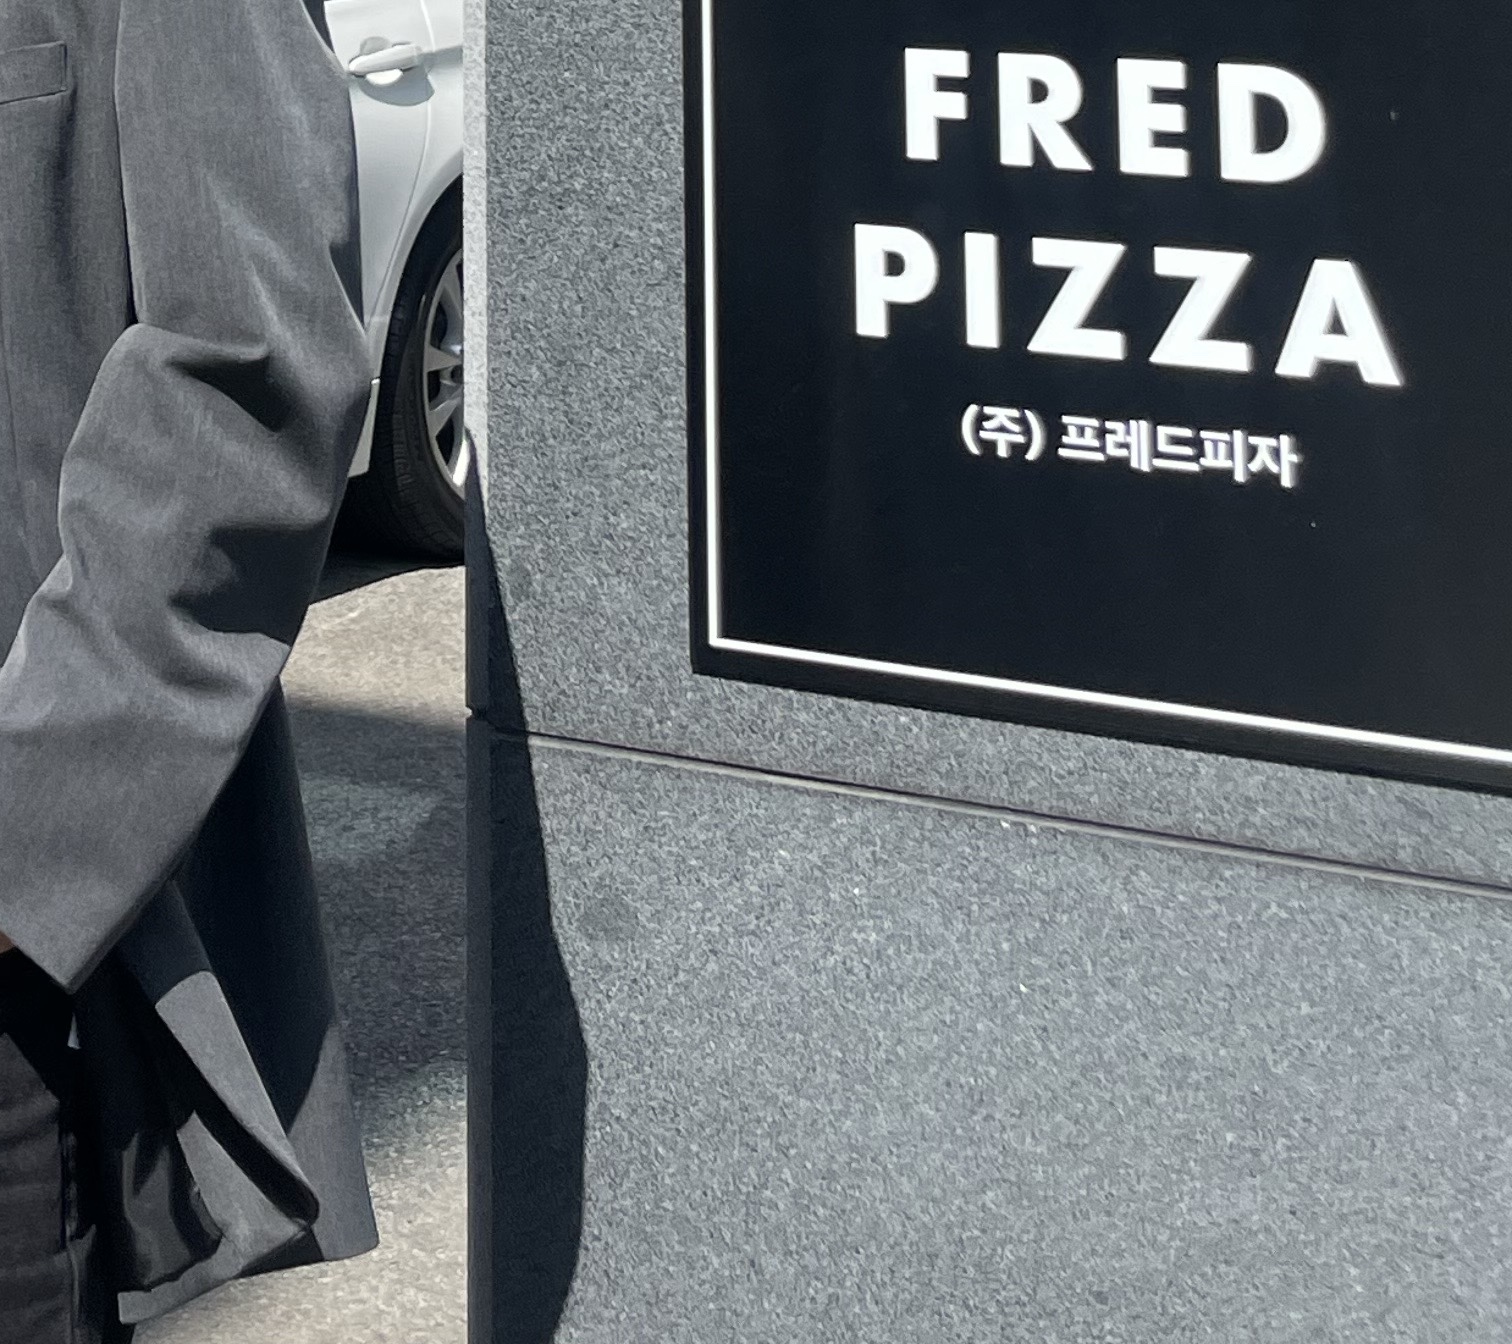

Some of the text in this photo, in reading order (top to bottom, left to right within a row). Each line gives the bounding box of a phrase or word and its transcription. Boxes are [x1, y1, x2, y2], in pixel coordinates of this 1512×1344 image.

[904, 47, 1327, 184] FRED
[854, 222, 1406, 388] PIZZA
[960, 403, 1303, 490] (주) 프레드피자
